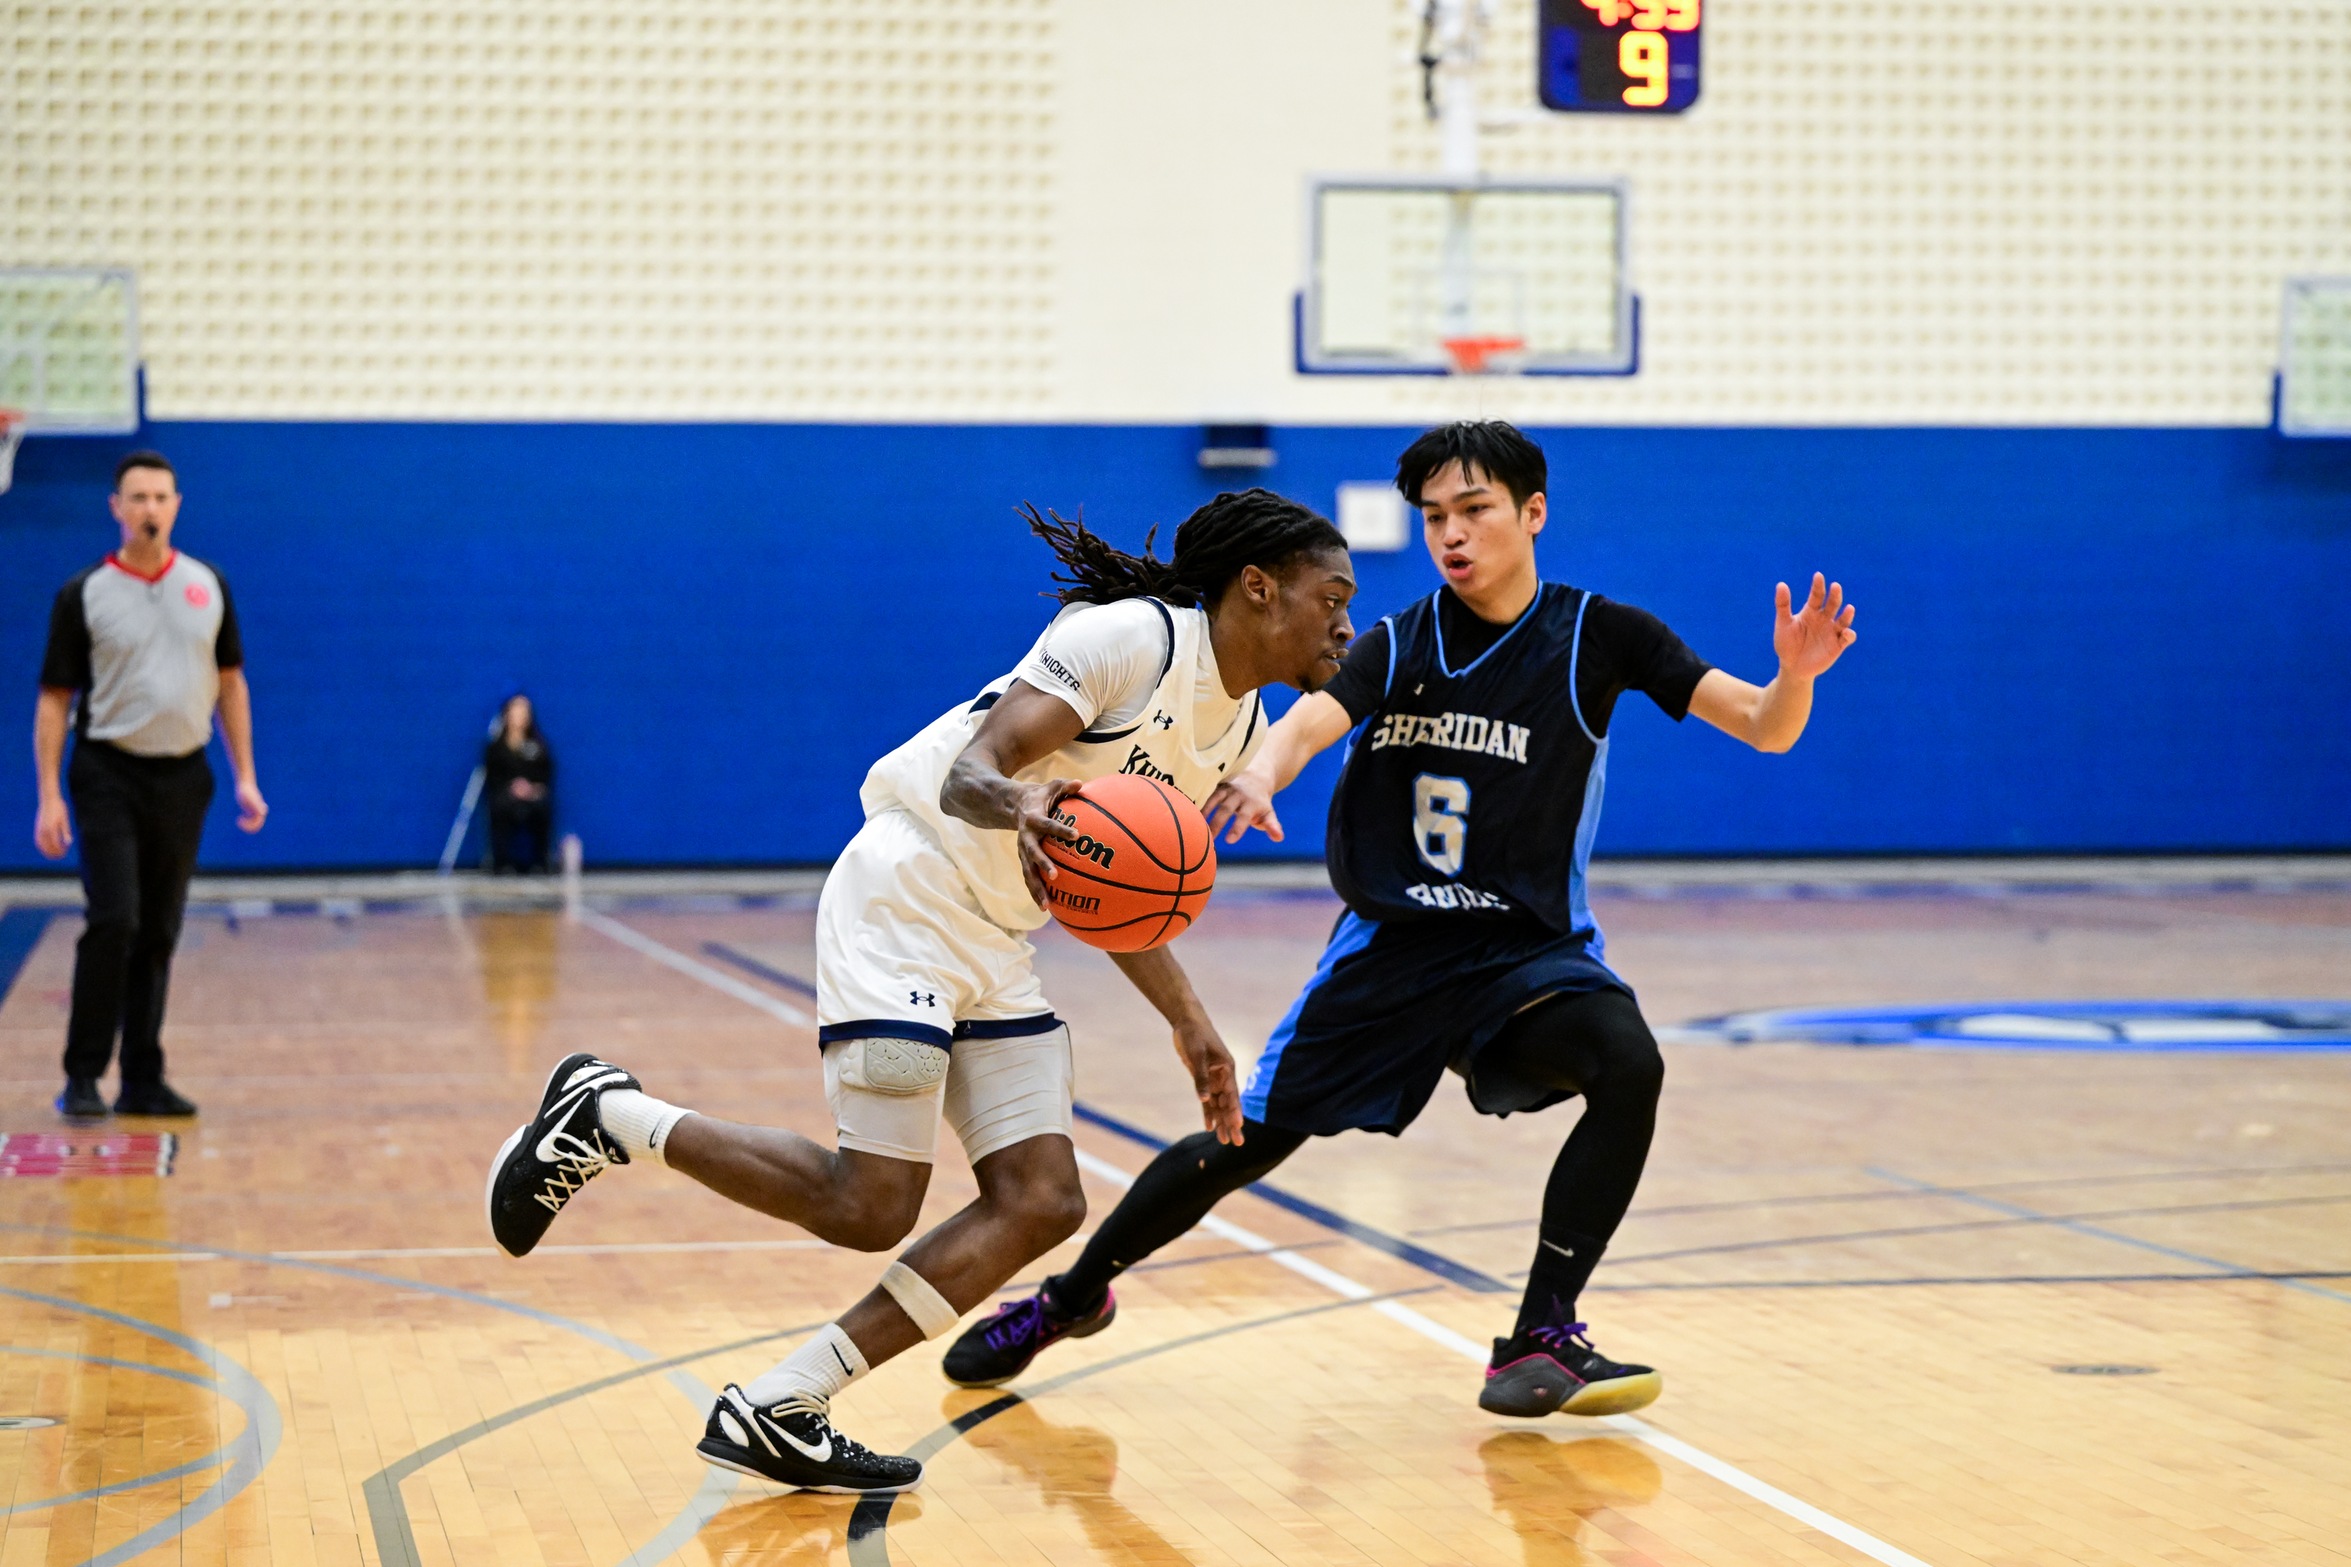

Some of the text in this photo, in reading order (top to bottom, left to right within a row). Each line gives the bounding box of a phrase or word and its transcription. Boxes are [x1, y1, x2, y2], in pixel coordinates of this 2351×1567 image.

[1619, 30, 1669, 107] 9
[1371, 711, 1531, 764] SHERIDAN
[1412, 771, 1472, 878] 6
